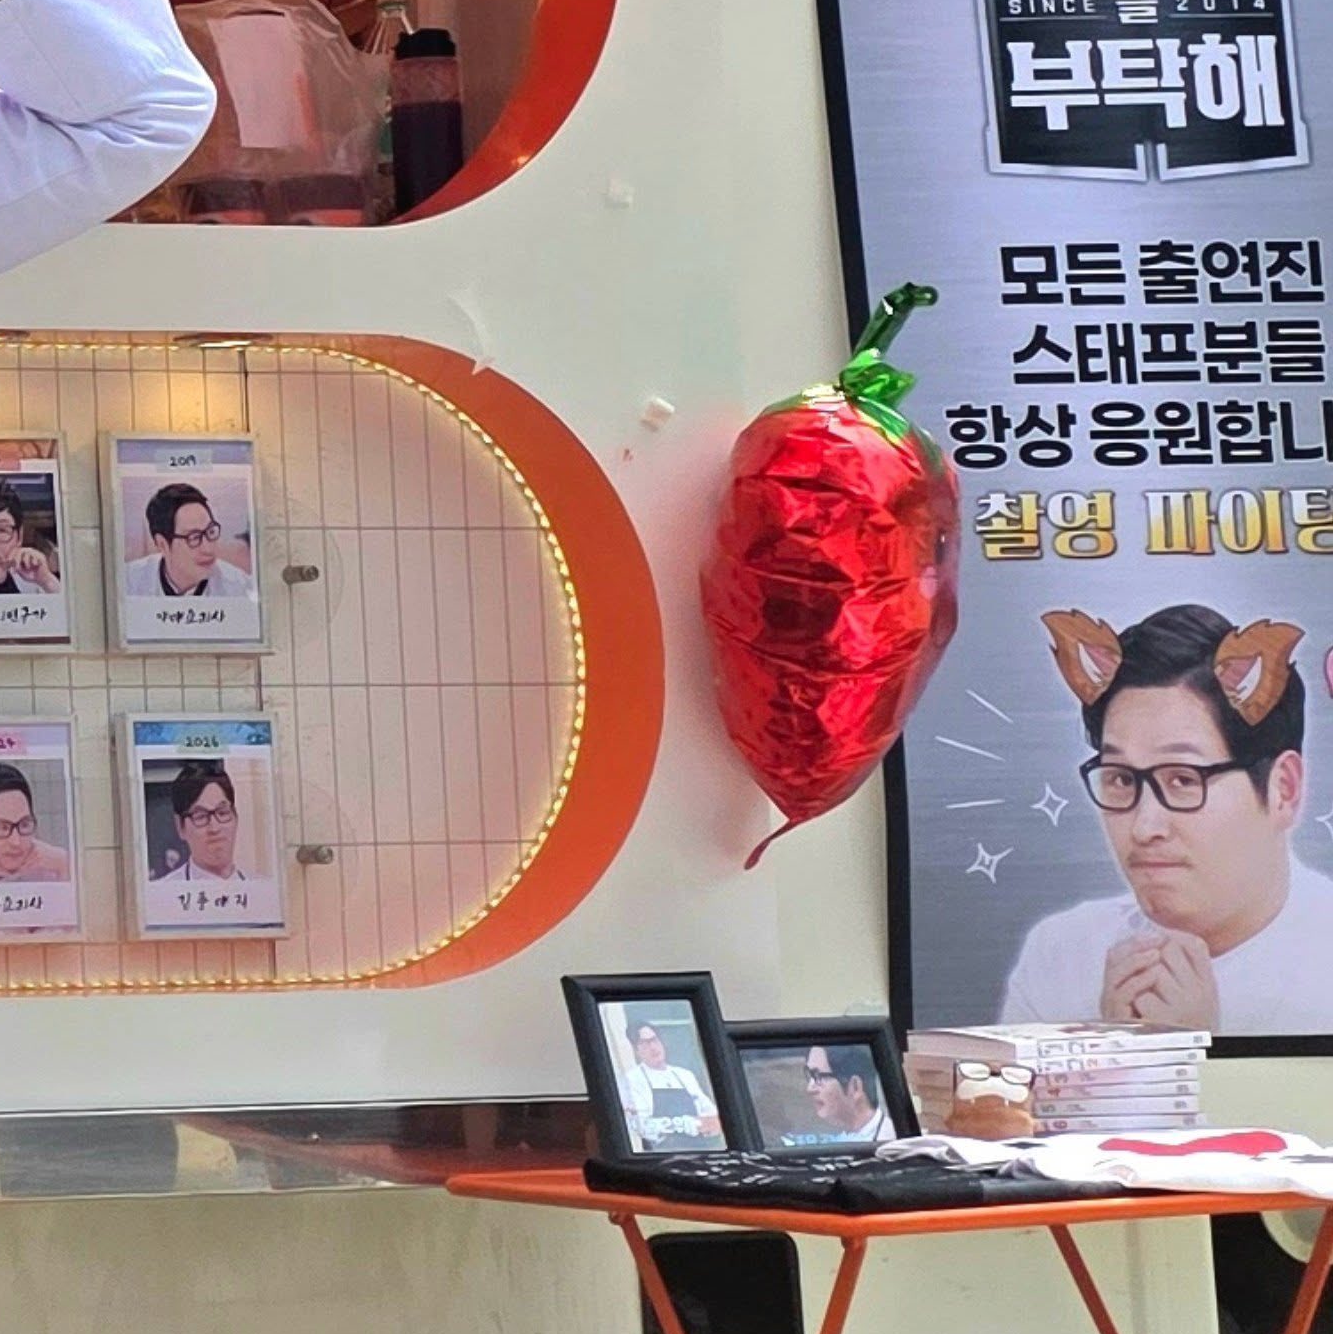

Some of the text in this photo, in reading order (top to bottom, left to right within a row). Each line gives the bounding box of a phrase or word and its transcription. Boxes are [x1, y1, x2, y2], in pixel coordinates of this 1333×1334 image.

[1007, 33, 1284, 130] 부탁해
[999, 239, 1326, 307] 모든 출연진
[1013, 321, 1326, 387] 스태프분들
[945, 403, 1077, 468] 항상
[975, 489, 1118, 561] 촬영
